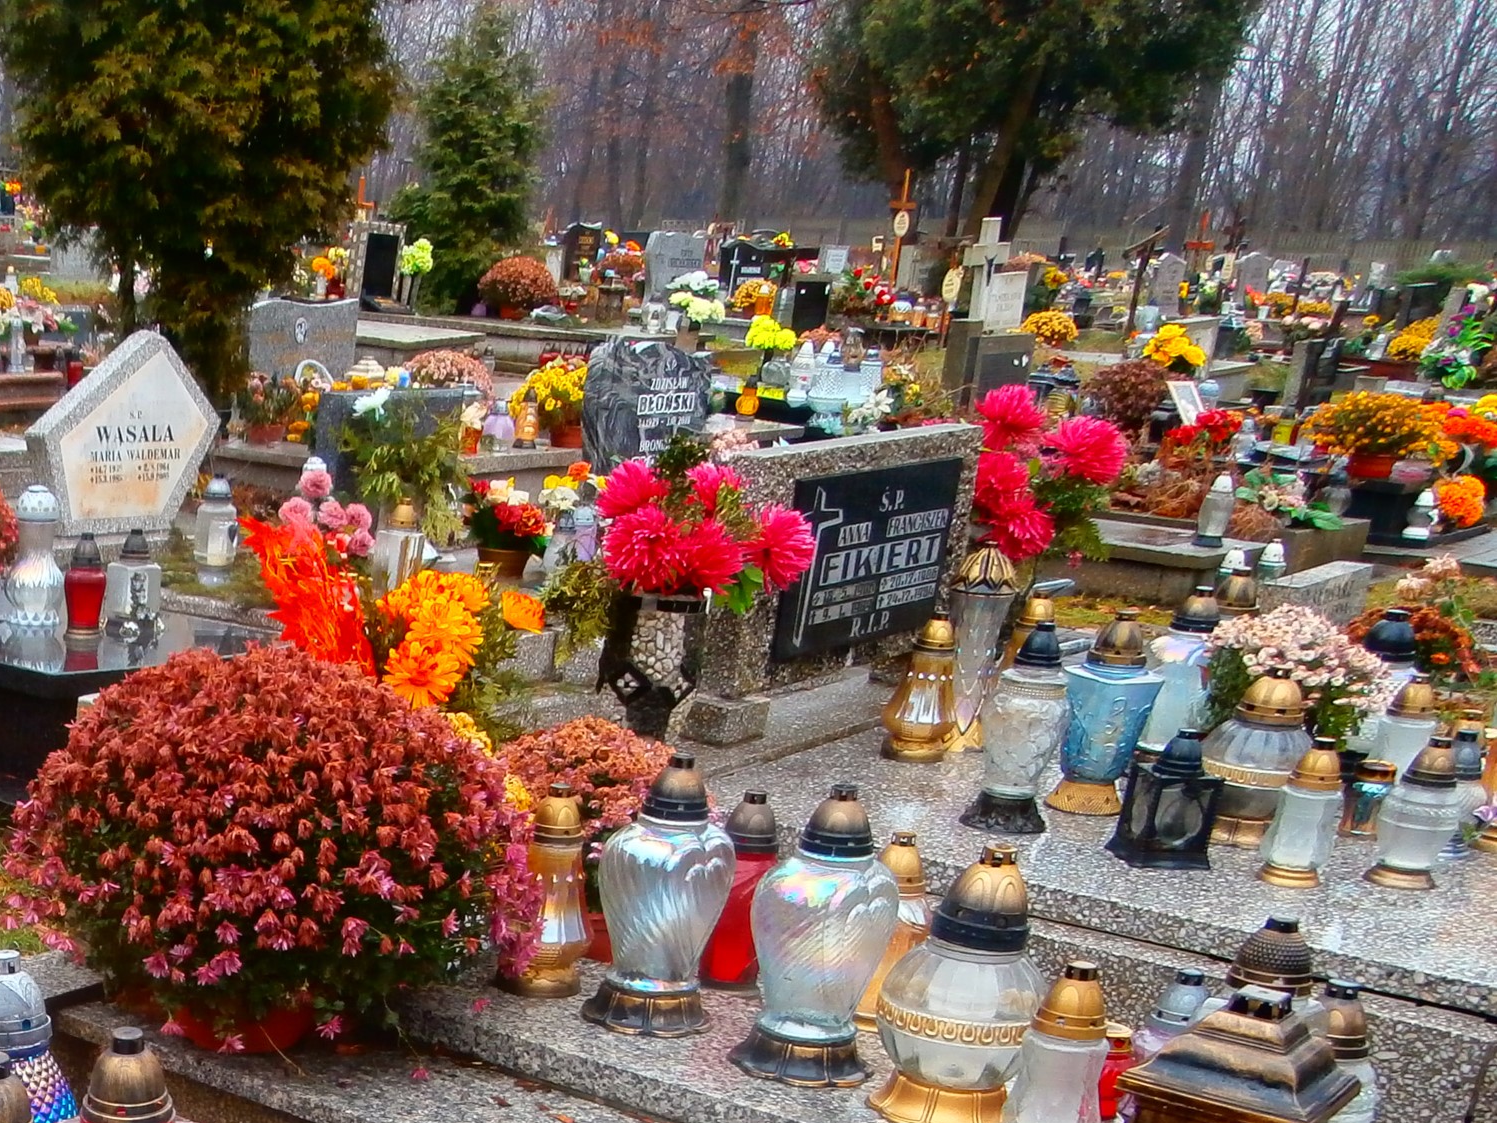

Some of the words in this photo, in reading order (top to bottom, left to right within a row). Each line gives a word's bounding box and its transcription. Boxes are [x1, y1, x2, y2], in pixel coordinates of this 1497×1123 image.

[637, 392, 695, 414] BŁOŃSKI
[90, 450, 122, 463] MARIA
[127, 448, 180, 461] WALDEMAR
[837, 521, 872, 548] ANNA
[886, 508, 949, 538] FRANCISZEK
[819, 533, 942, 587] FIKIERT
[850, 610, 890, 638] R.I.P.
